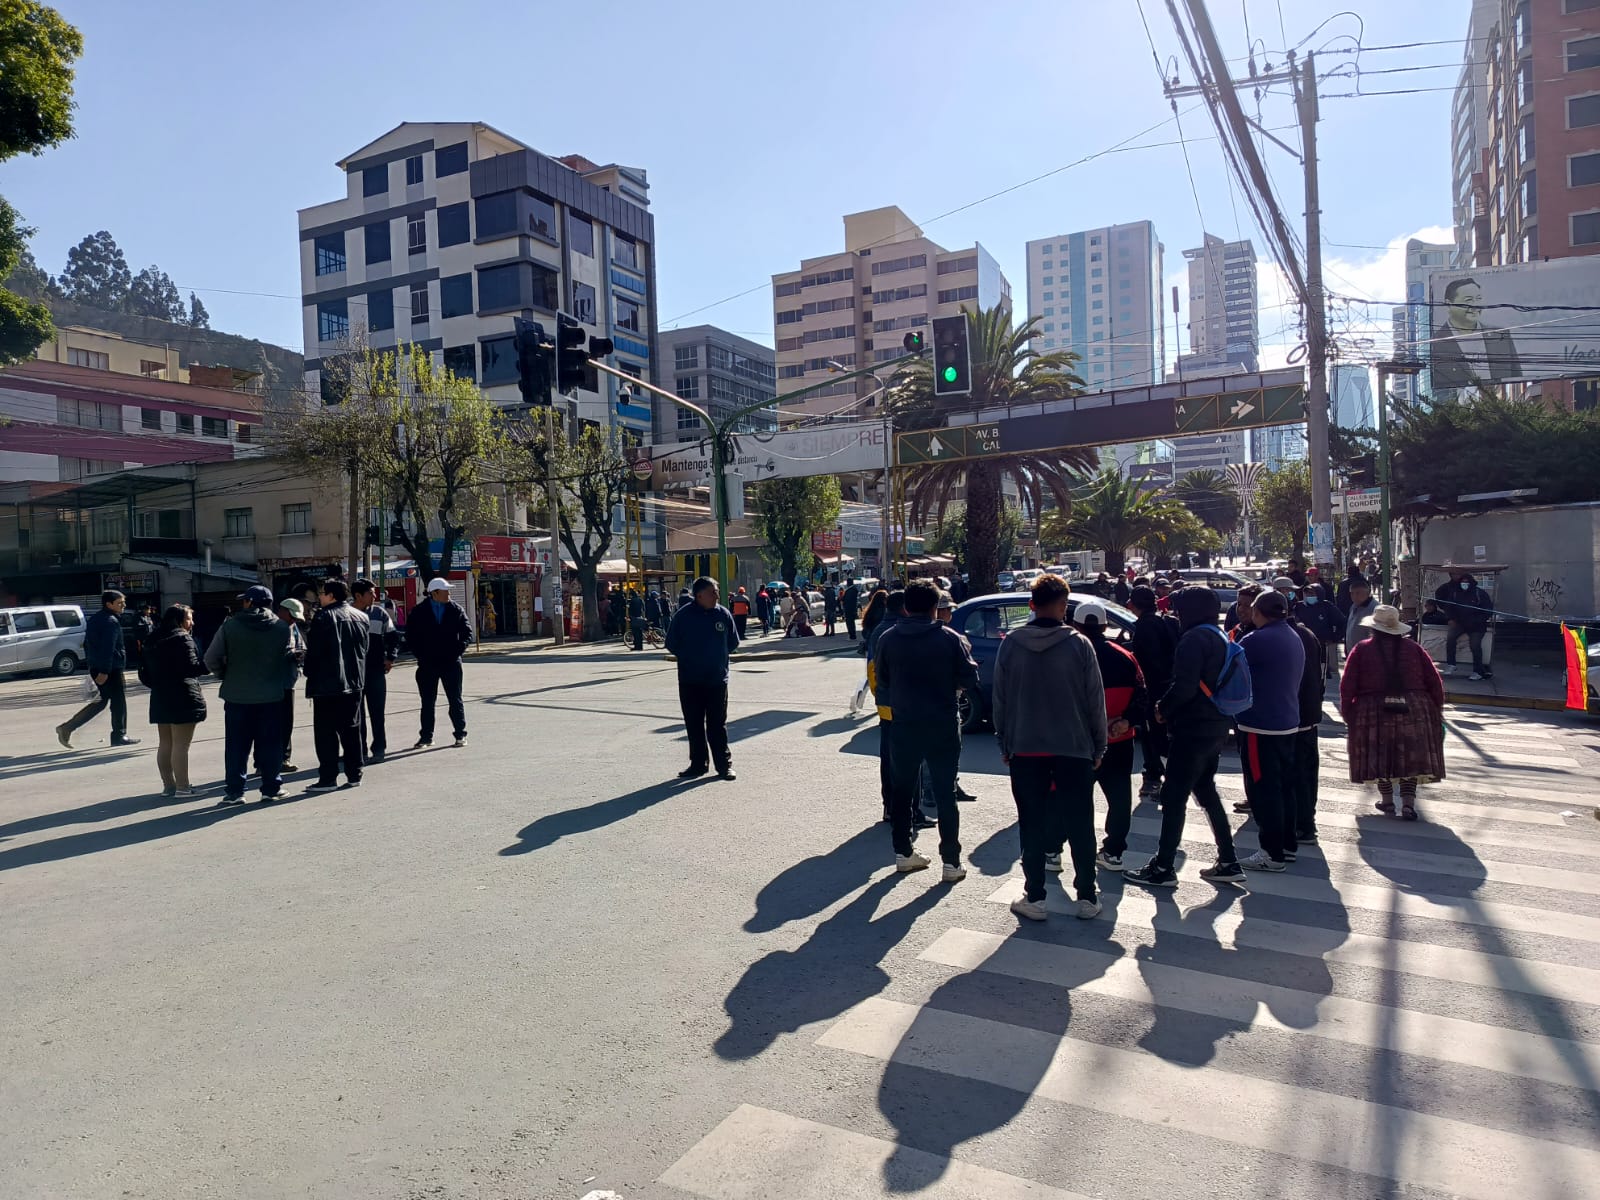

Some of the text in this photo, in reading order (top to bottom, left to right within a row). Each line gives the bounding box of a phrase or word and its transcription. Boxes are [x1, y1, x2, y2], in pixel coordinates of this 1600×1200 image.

[975, 428, 1000, 440] AV. B
[801, 428, 884, 454] SIEMPRE
[661, 459, 708, 472] Mantenga
